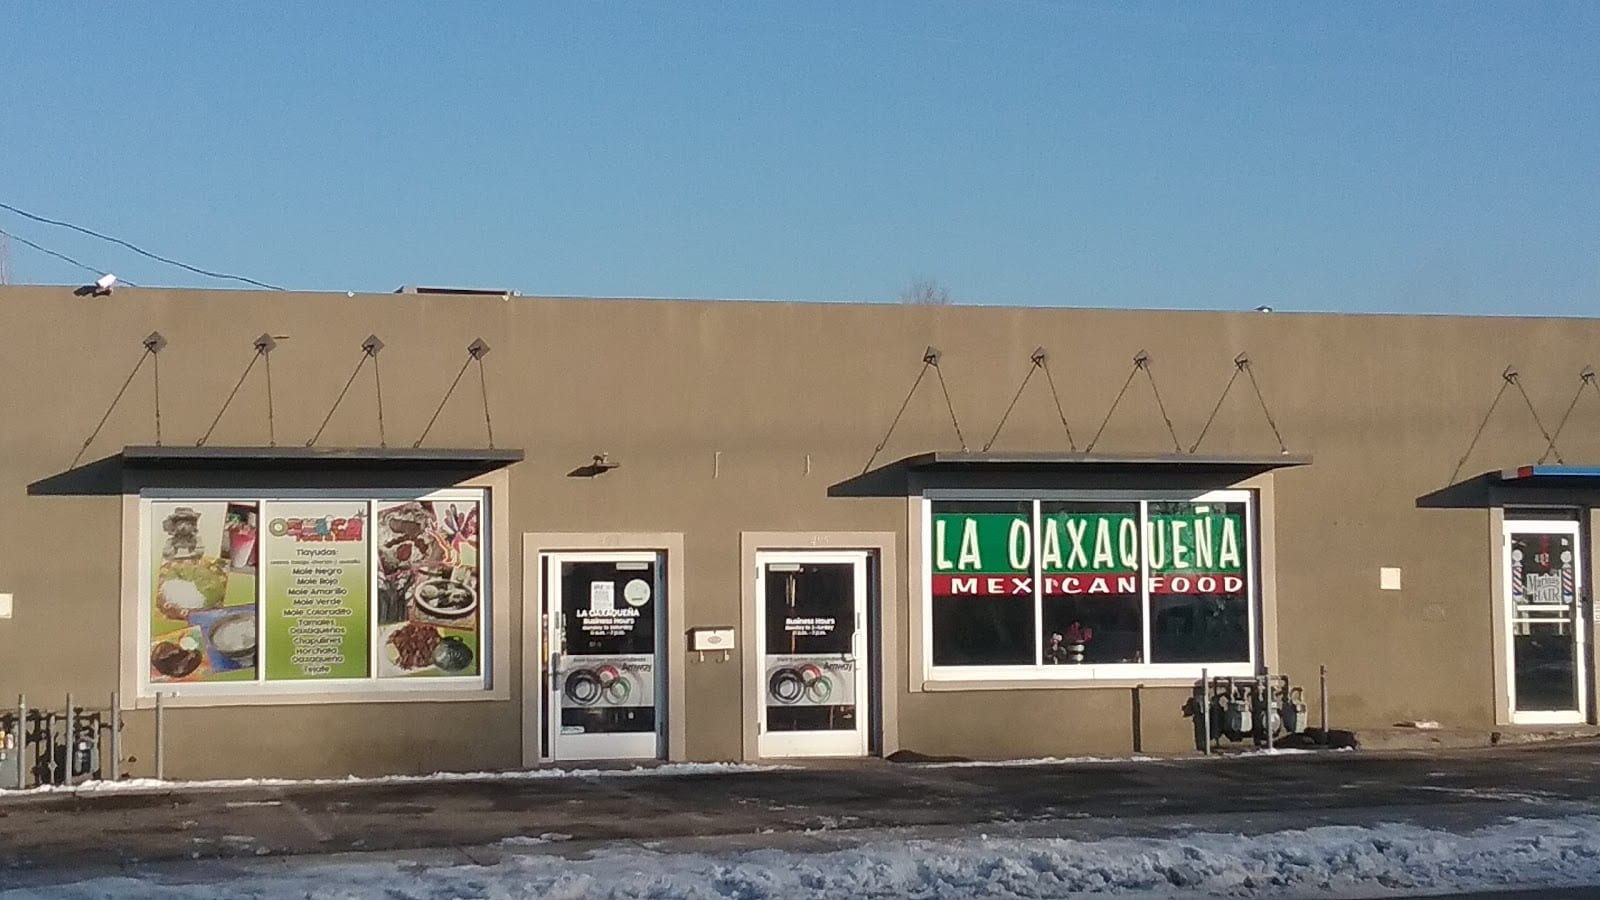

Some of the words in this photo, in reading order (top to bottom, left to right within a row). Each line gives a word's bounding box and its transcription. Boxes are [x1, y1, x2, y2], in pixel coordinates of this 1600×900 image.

[936, 518, 982, 570] LA
[1008, 506, 1241, 571] OAXAQUEÑA
[315, 568, 343, 576] Negro
[320, 578, 338, 586] Rojo
[951, 577, 1137, 594] MEXICAN
[1149, 577, 1243, 593] FOOD
[576, 609, 588, 617] LA
[786, 617, 814, 625] Business
[293, 637, 341, 645] Chapulines
[824, 662, 853, 671] Amway
